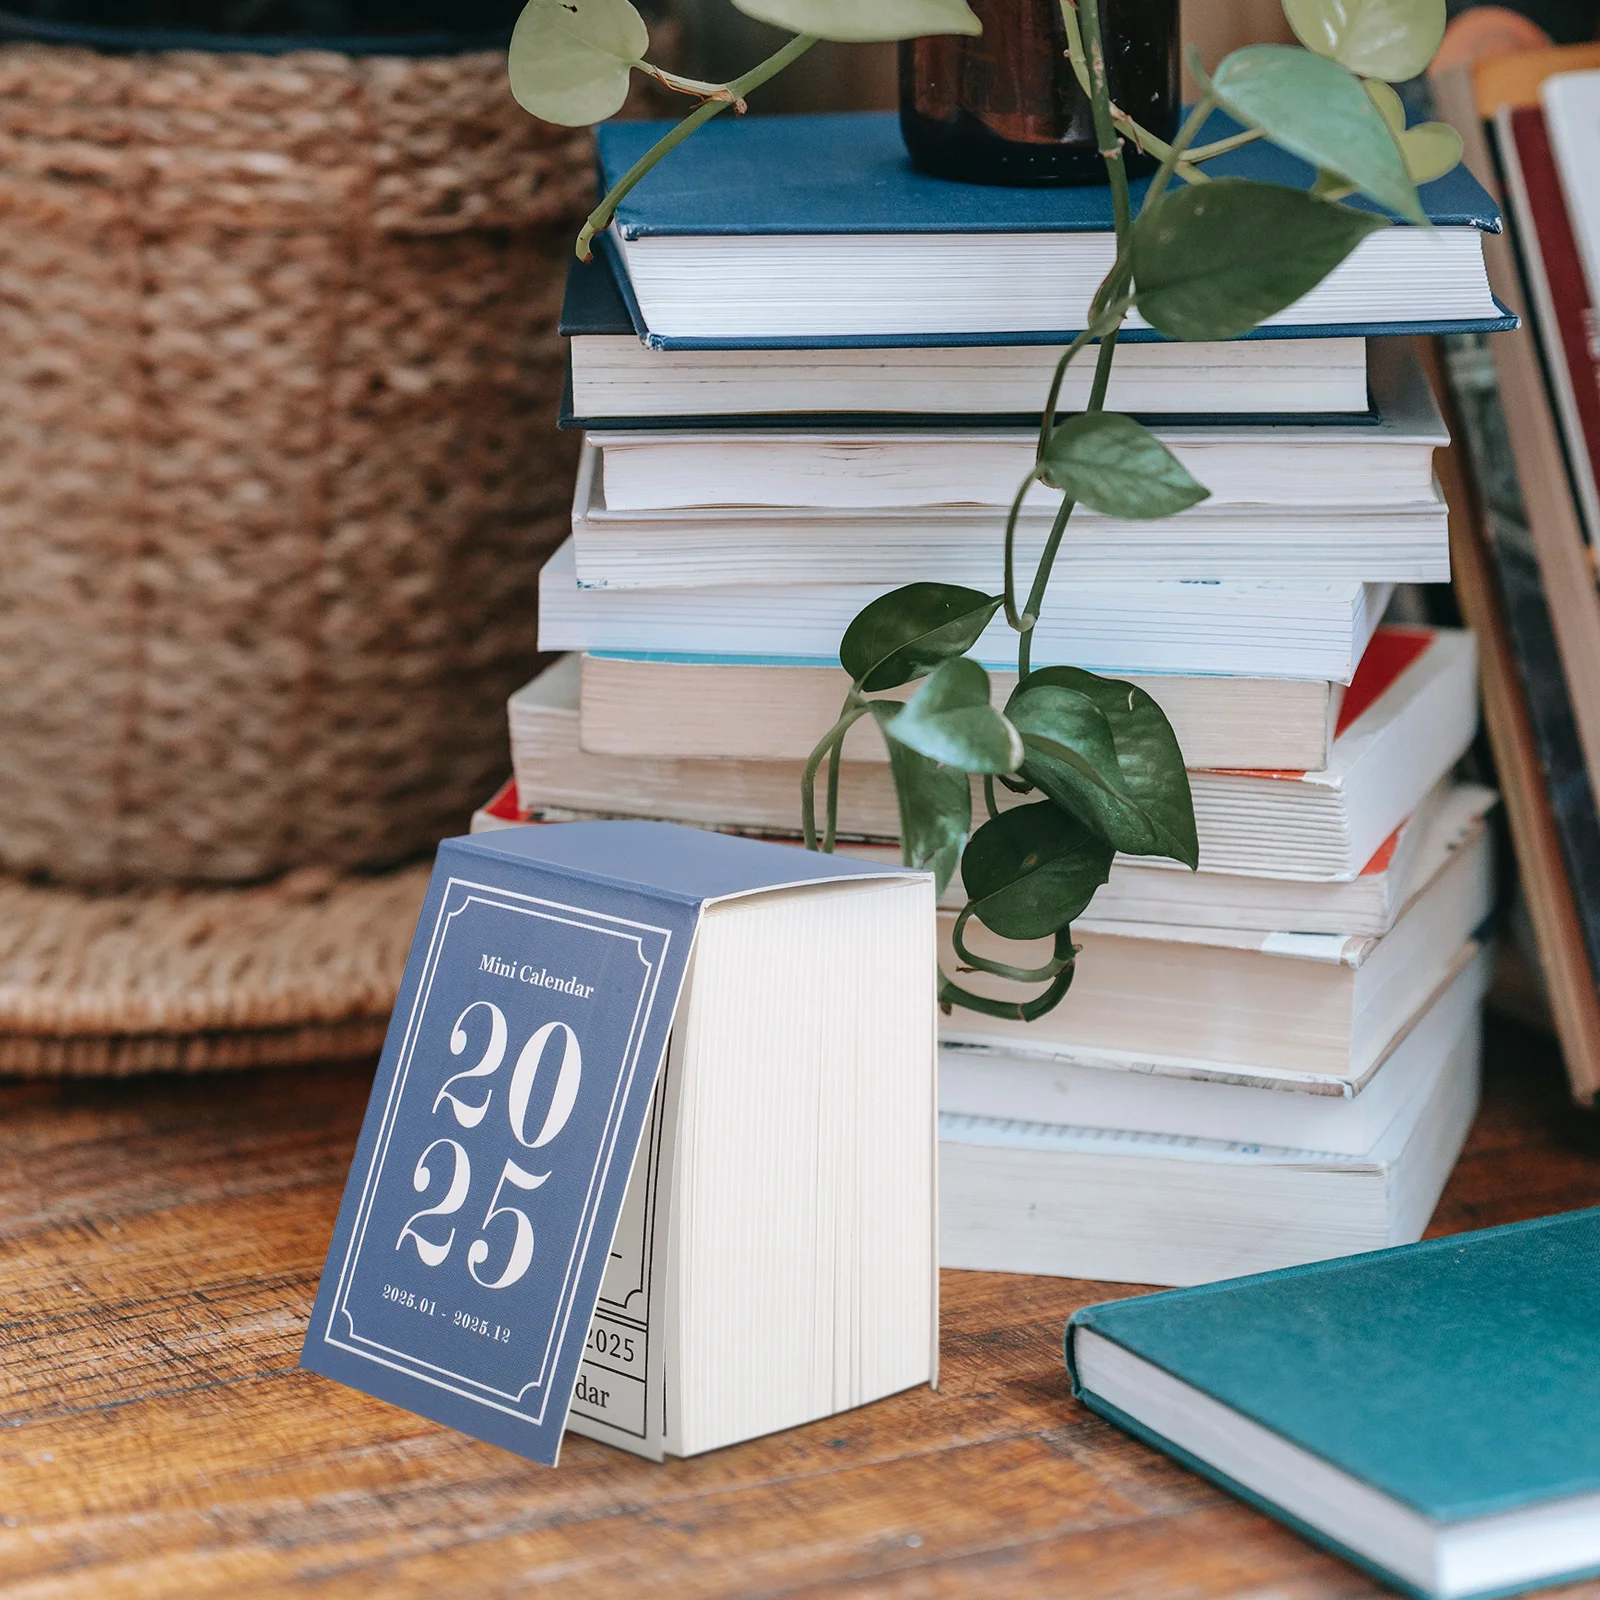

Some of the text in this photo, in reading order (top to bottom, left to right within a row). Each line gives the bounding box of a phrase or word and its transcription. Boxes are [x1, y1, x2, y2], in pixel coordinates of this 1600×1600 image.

[478, 954, 595, 999] Mini Calendar
[431, 1001, 582, 1148] 20
[395, 1138, 552, 1289] 25
[381, 1283, 437, 1317] 2025.01
[453, 1310, 511, 1343] 2025.12
